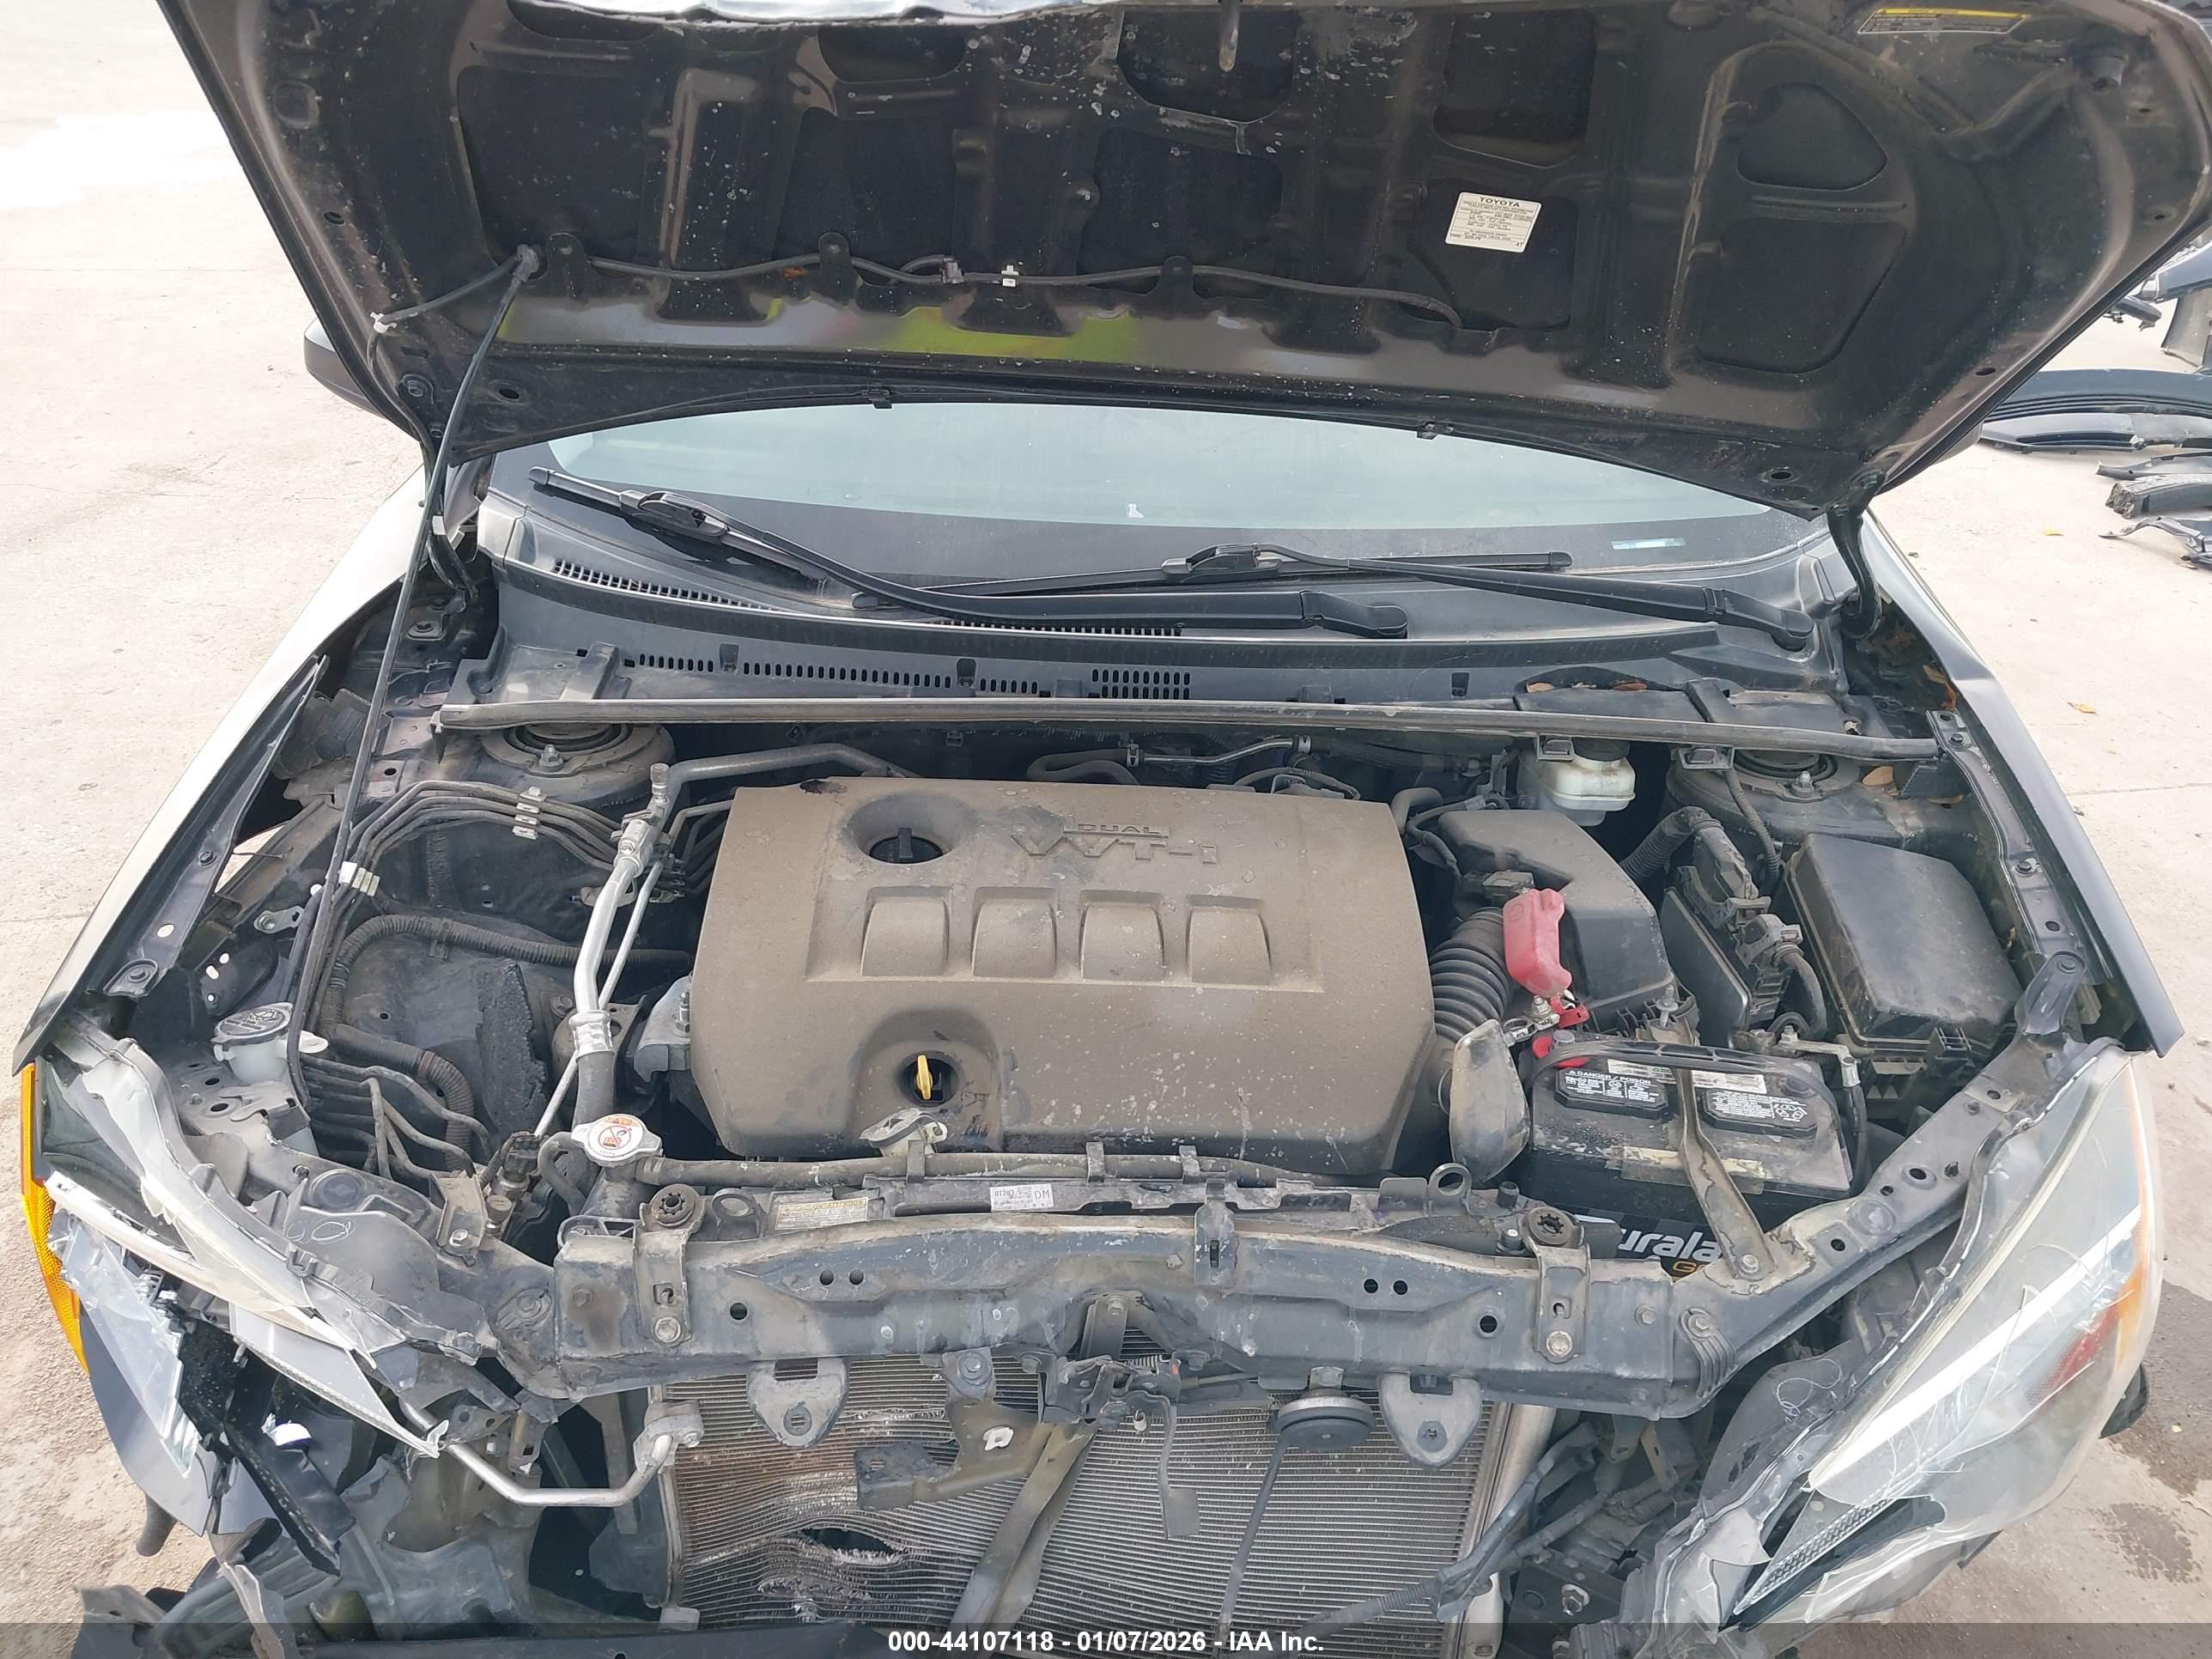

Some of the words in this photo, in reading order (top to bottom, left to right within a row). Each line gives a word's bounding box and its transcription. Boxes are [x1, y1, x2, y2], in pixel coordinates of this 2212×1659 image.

[1480, 197, 1520, 208] TOYOTA
[1078, 823, 1161, 834] DUAL
[1576, 1070, 1612, 1080] DANGER
[1620, 1076, 1652, 1085] POISON
[1034, 1188, 1051, 1200] DM
[1618, 1228, 1723, 1263] urala
